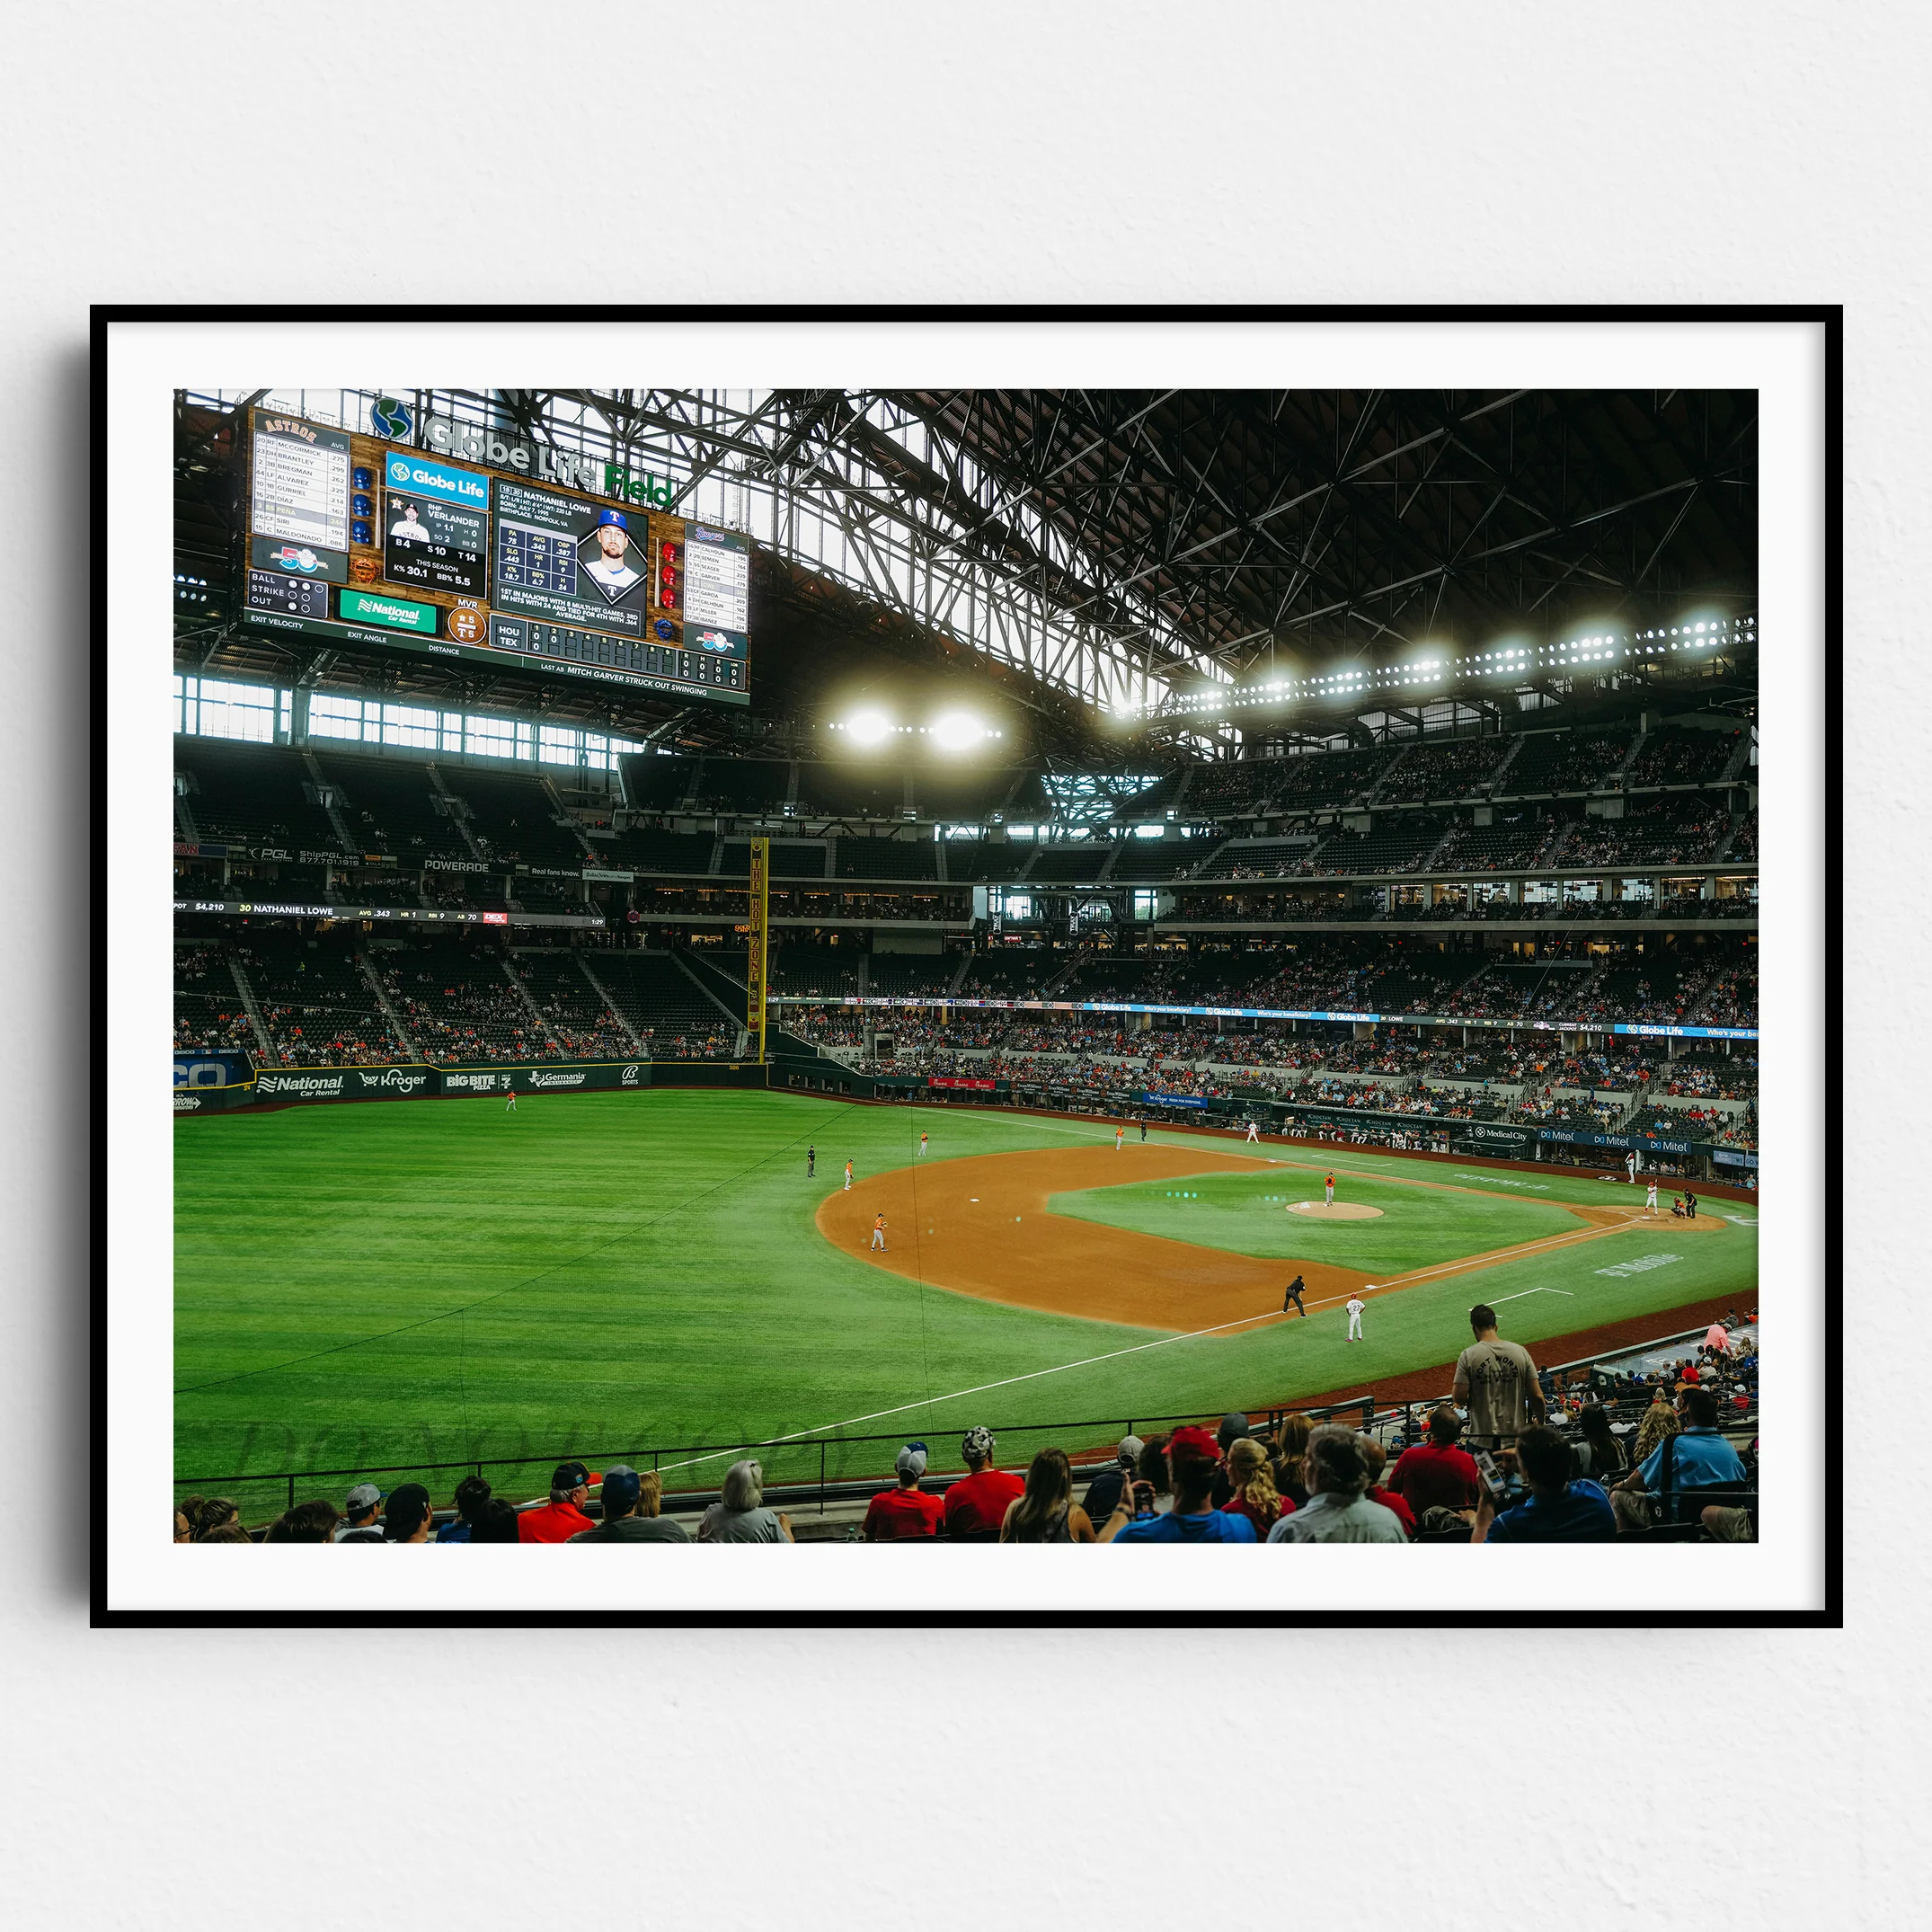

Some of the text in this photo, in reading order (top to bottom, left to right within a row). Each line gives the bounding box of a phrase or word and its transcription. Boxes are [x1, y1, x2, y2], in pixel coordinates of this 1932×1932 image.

[265, 420, 317, 444] ASTROS
[278, 441, 322, 457] MCCORMICK
[278, 453, 315, 465] BRANTLEY
[424, 416, 672, 508] Globe Life Field
[278, 464, 313, 476] BREGMAN
[277, 474, 309, 487] ALVAREZ
[412, 469, 484, 498] Globe Life
[277, 485, 306, 497] GURRIEL
[428, 503, 443, 511] RHP
[524, 492, 591, 514] NATHANIEL LOWE
[276, 518, 290, 526] SIRI
[428, 510, 480, 528] VERLANDER
[276, 528, 323, 543] MALDONADO
[395, 538, 403, 546] B
[403, 540, 411, 549] 4
[434, 546, 447, 556] 10
[465, 553, 476, 563] 14
[416, 558, 458, 573] THIS SEASON
[252, 573, 276, 584] BALL
[407, 565, 428, 578] 30.1
[455, 576, 471, 587] 5.5
[252, 585, 285, 597] STRIKE
[252, 596, 272, 606] OUT
[457, 598, 478, 609] MVR
[501, 588, 512, 597] 1ST
[521, 592, 549, 603] MAJORS
[549, 598, 566, 607] WITH
[572, 602, 602, 614] MULTI-HIT
[625, 613, 639, 621] 3RD
[501, 594, 510, 602] IN
[510, 596, 525, 605] HITS
[526, 598, 543, 607] WITH
[552, 604, 567, 612] AND
[567, 607, 582, 615] TIED
[582, 609, 596, 617] FOR
[596, 611, 608, 620] 4TH
[608, 614, 625, 624] WITH
[251, 615, 304, 629] EXIT VELOCITY
[398, 616, 418, 625] Rental
[555, 610, 587, 623] AVERAGE.
[499, 625, 519, 636] HOU
[347, 631, 387, 643] EXIT ANGLE
[500, 635, 518, 647] TEX
[429, 644, 460, 656] DISTANCE
[541, 663, 554, 671] LAST
[567, 666, 592, 677] MITCH
[593, 670, 625, 683] GARVER
[625, 676, 654, 687] STRUCK
[655, 681, 669, 690] OUT
[671, 683, 707, 696] SWINGING
[261, 848, 293, 859] PGL
[300, 850, 359, 861] ShipPGL.com
[531, 867, 546, 875] Real
[546, 868, 560, 876] fans
[561, 869, 580, 877] know.
[752, 858, 761, 891] THE
[195, 902, 225, 912] $4,210
[239, 904, 252, 912] 30
[253, 904, 306, 914] NATHANIEL
[307, 907, 333, 916] LOWE
[751, 899, 760, 931] HOT
[750, 937, 759, 982] ZONE
[1231, 1008, 1243, 1016] Life
[1336, 1013, 1370, 1022] Globe Life
[1580, 1024, 1602, 1032] $4,210
[1639, 1026, 1684, 1035] Globe Life
[1729, 1031, 1746, 1039] your
[469, 1074, 497, 1086] BITE
[545, 1072, 586, 1082] Germania
[315, 1088, 341, 1096] Rental
[1486, 1129, 1527, 1142] Medical City
[1552, 1130, 1574, 1141] Mitel
[1606, 1135, 1630, 1147] Mitel
[1662, 1140, 1688, 1152] Mitel
[1494, 1355, 1519, 1378] WORTH
